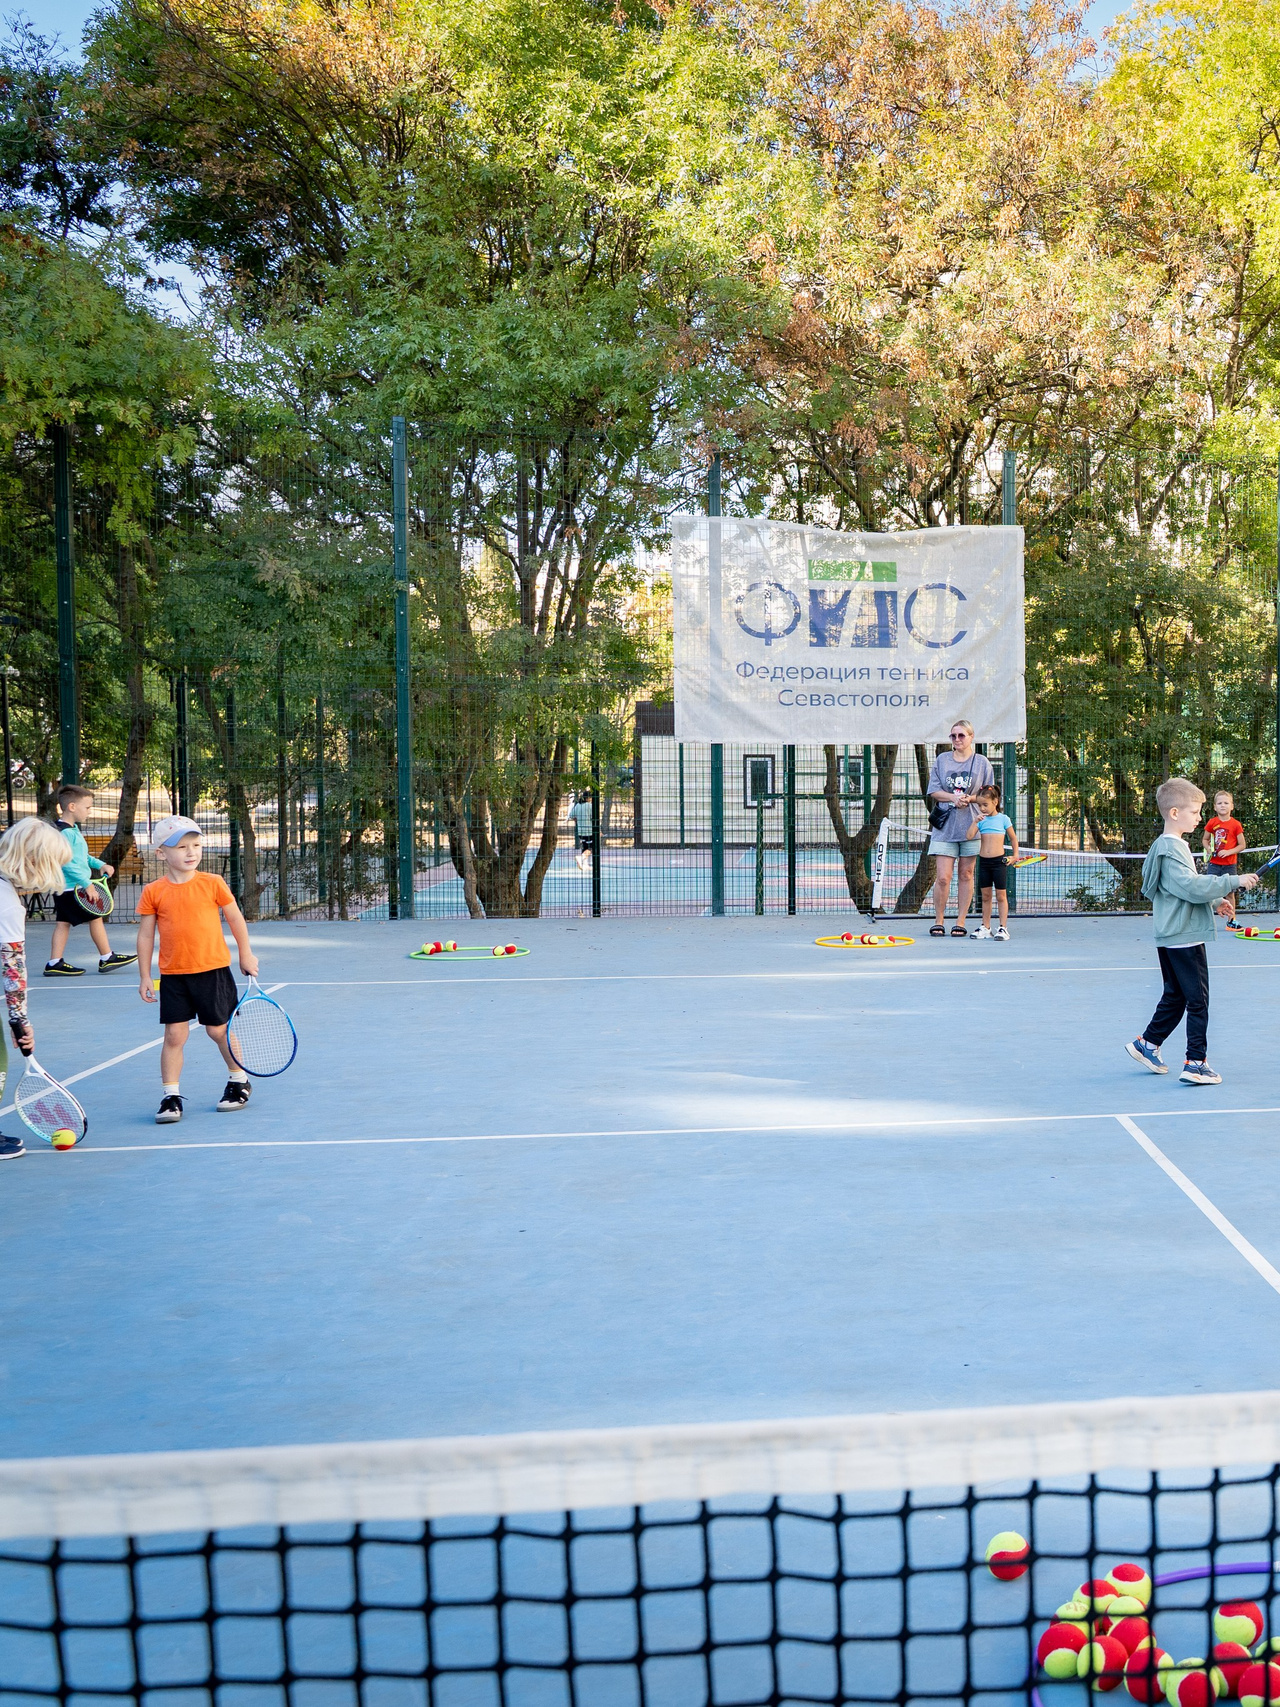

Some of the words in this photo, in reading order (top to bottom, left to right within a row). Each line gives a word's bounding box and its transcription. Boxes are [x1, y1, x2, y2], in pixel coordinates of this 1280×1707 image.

[736, 661, 870, 684] Федерация
[877, 666, 969, 681] тенниса
[778, 689, 930, 707] Севастополя
[876, 843, 884, 882] HEAD
